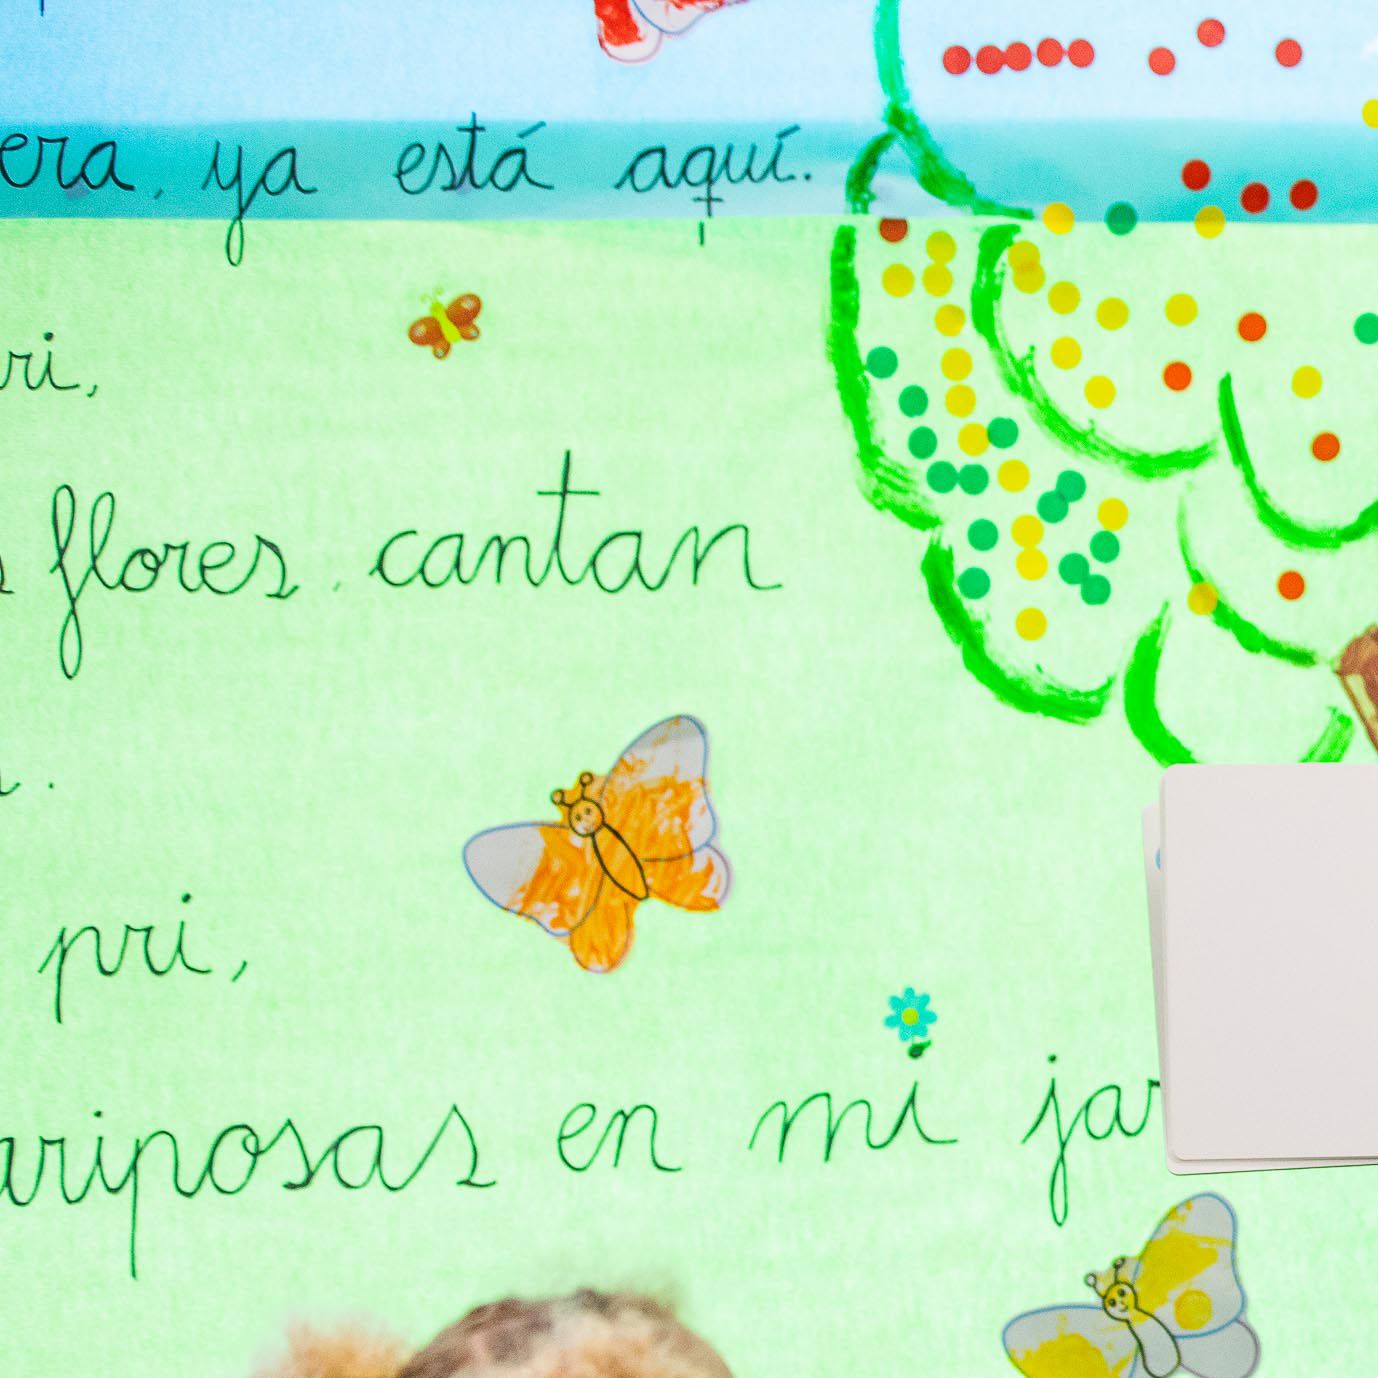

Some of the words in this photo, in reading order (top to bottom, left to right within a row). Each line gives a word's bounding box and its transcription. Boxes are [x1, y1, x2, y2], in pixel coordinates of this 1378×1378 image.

[202, 137, 317, 266] ya
[397, 111, 555, 195] está
[614, 125, 814, 247] aquí.
[368, 448, 784, 595] cantan
[557, 1100, 683, 1174] en
[748, 1040, 958, 1165] mi
